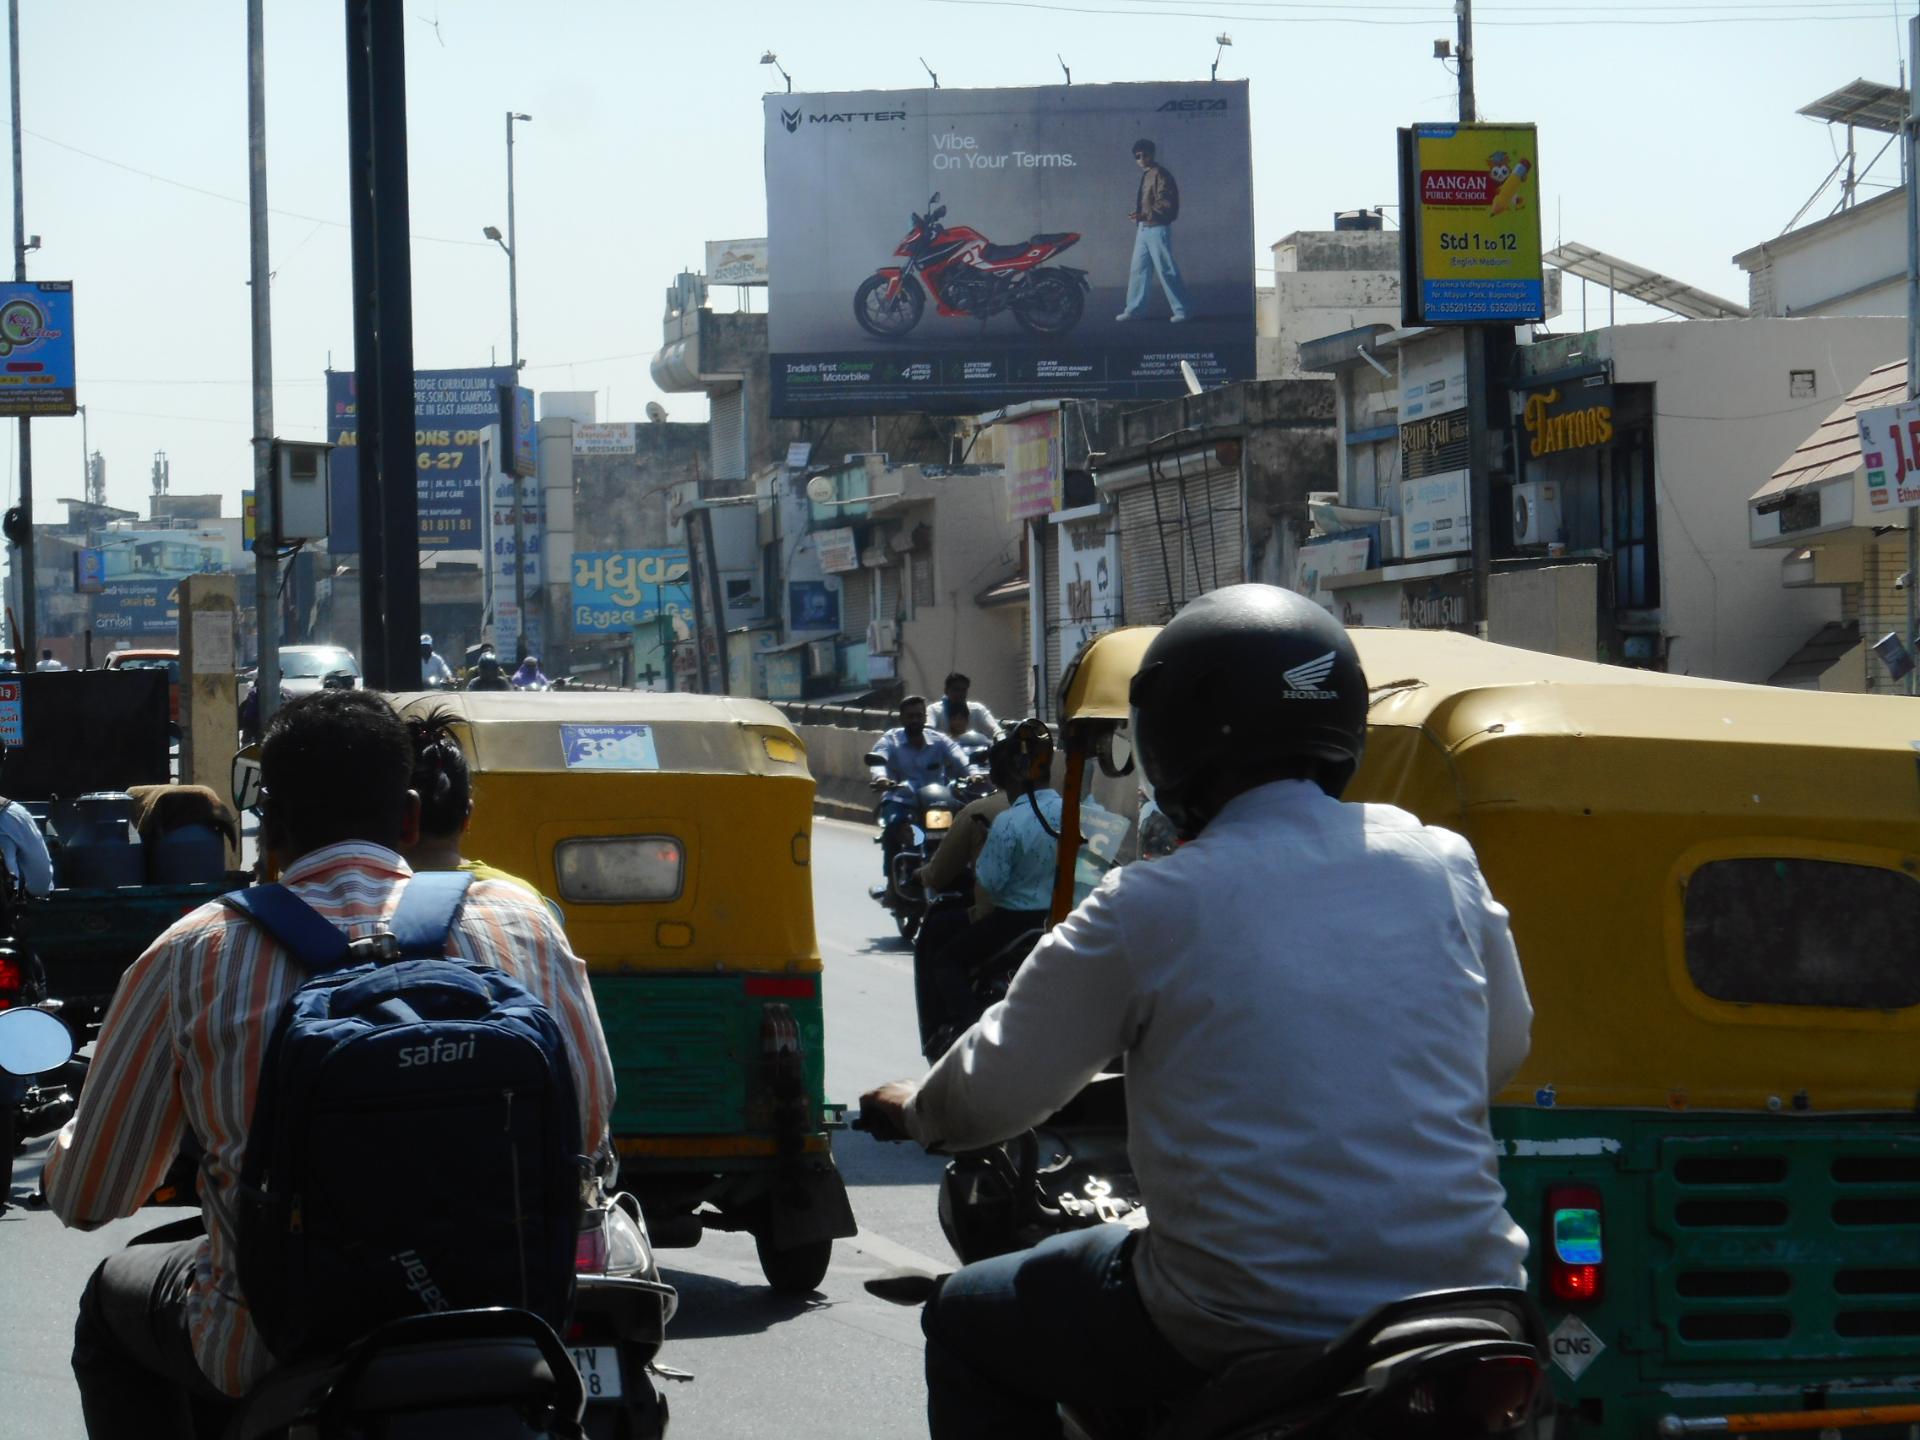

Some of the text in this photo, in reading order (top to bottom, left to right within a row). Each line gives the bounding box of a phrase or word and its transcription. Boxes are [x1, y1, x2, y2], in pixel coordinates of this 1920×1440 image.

[808, 110, 907, 124] MATTER
[932, 133, 979, 150] Vibe.
[932, 150, 1077, 170] On Your Terms.
[1425, 176, 1487, 190] AANGAN
[1425, 191, 1488, 200] PUBLIC SCHOOL
[1440, 233, 1517, 250] Std 1 to 12
[1451, 256, 1477, 268] English
[786, 363, 818, 374] India's
[818, 362, 838, 373] first
[901, 367, 911, 379] 4
[438, 378, 488, 391] CURRICULUM
[488, 379, 496, 390] &
[822, 372, 871, 383] Motorbike
[460, 390, 492, 402] CAMPUS
[427, 403, 435, 415] IN
[436, 402, 455, 415] EAST
[456, 401, 500, 415] AHMEDABA
[96, 614, 133, 629] ambit
[1282, 690, 1338, 700] HONDA
[398, 1034, 476, 1068] safari
[391, 1249, 449, 1313] safari
[1553, 1337, 1592, 1355] CNG
